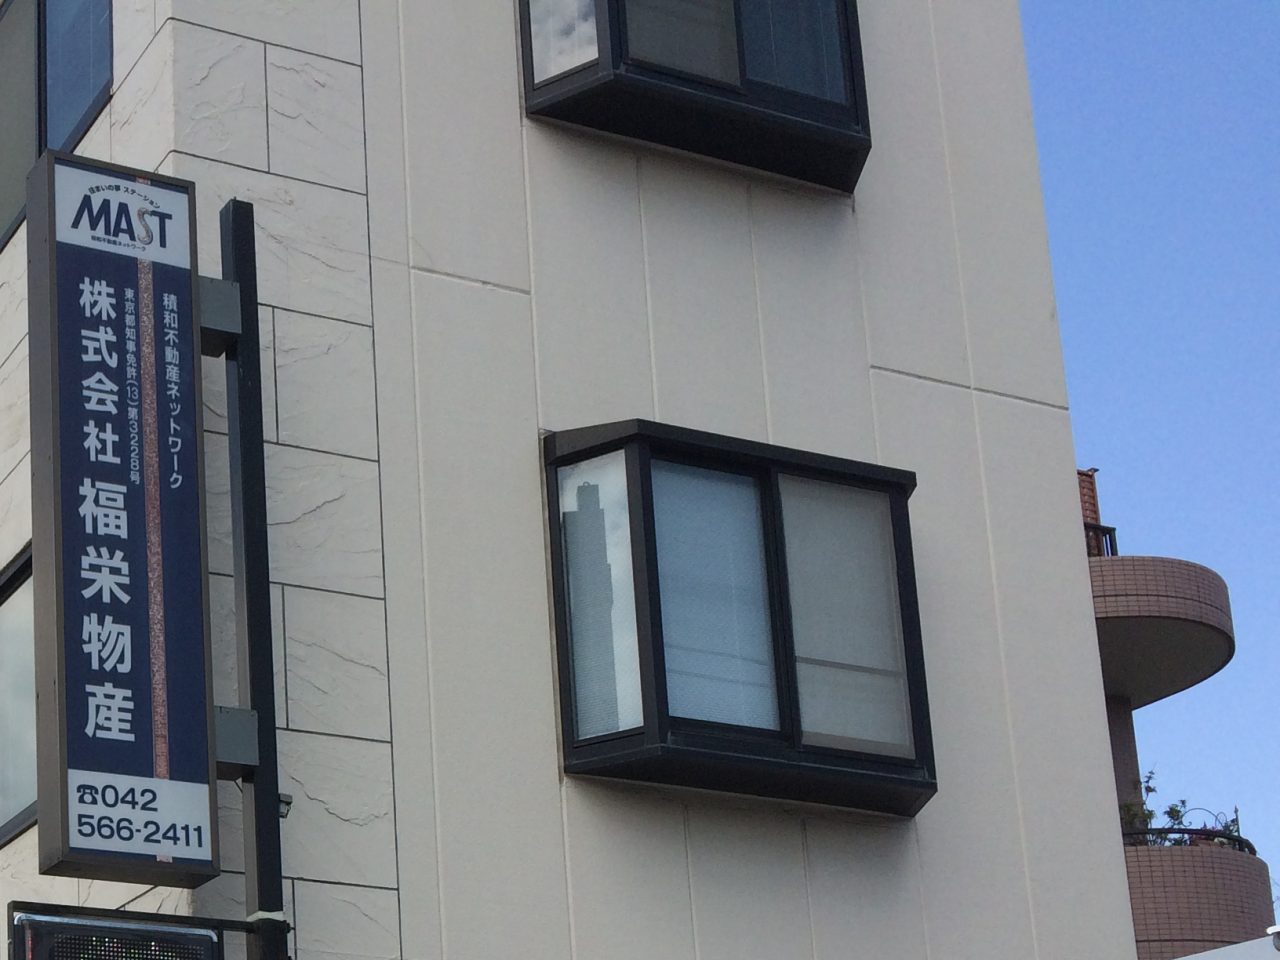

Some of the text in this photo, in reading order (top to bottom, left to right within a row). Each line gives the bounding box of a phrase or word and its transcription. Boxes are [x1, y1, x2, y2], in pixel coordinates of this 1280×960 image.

[71, 194, 172, 248] MAST
[162, 292, 183, 490] 積和不動産ネットワーク
[77, 276, 136, 743] 株式会社福栄物産
[76, 813, 204, 849] 566-2411
